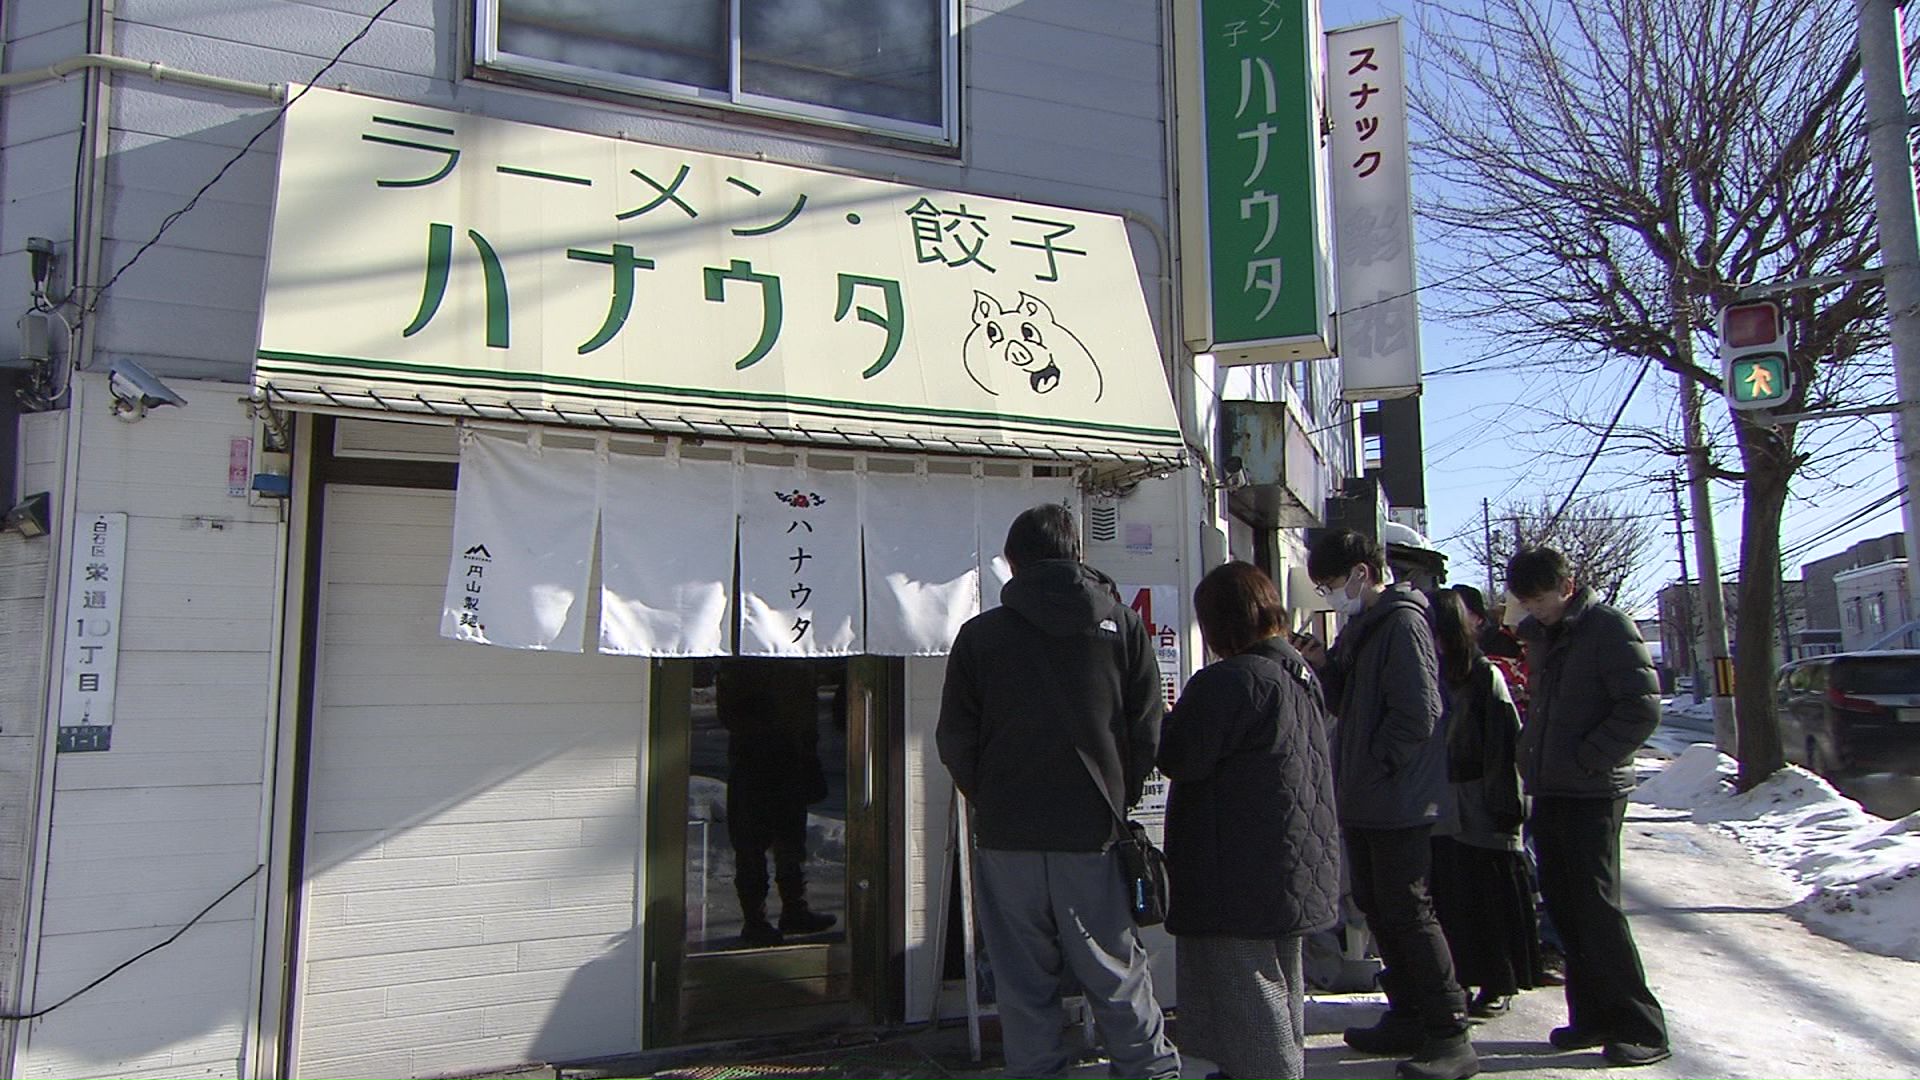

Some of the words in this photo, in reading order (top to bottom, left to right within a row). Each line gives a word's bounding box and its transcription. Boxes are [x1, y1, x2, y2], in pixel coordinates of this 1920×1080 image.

[1347, 46, 1382, 179] スナック
[361, 114, 1088, 284] ラーメン・餃子
[1234, 56, 1284, 322] ハナウタ
[402, 222, 907, 380] ハナウタ
[786, 519, 814, 644] ハナウタ
[70, 735, 99, 748] 1-1
